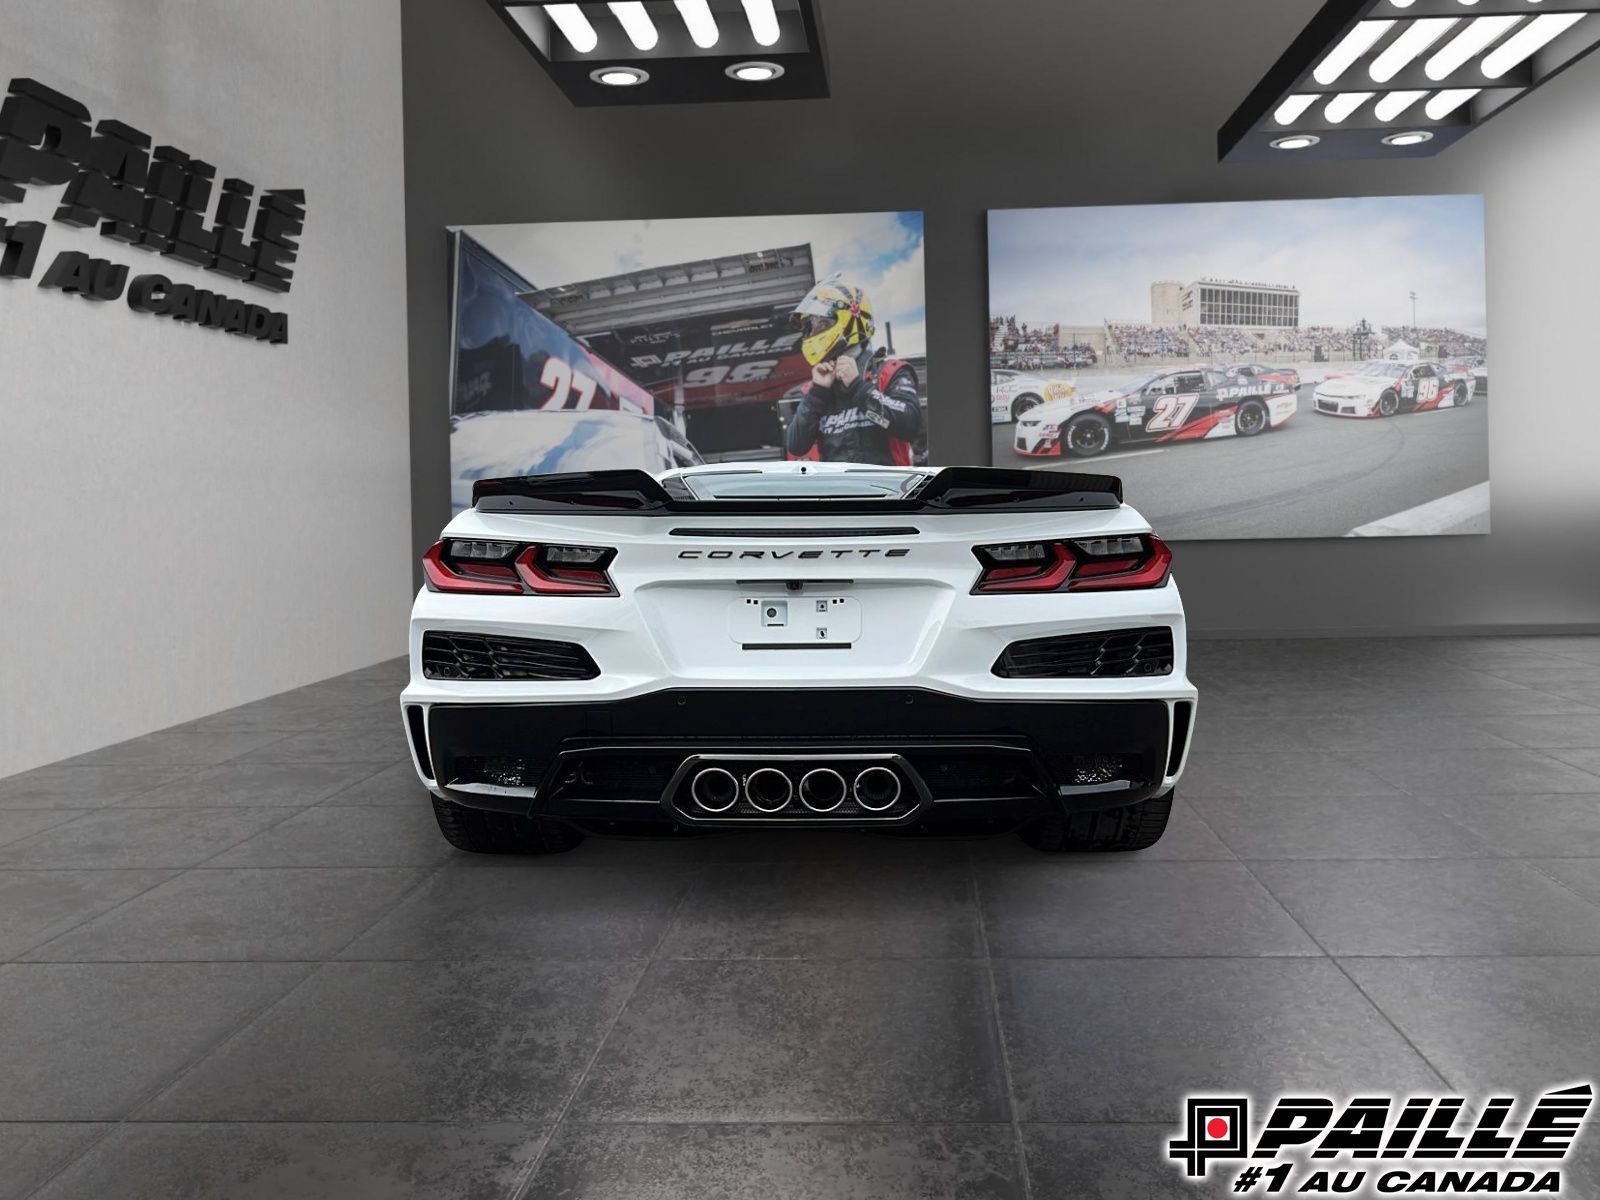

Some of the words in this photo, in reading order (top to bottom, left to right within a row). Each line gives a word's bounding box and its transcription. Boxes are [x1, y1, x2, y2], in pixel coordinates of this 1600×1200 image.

[0, 217, 47, 280] 1
[38, 251, 130, 301] AU
[127, 274, 288, 344] CANADA
[540, 356, 597, 412] 27
[682, 360, 778, 388] 96
[1416, 377, 1438, 403] 96
[1145, 393, 1199, 432] 27
[677, 548, 911, 560] CORVETTE
